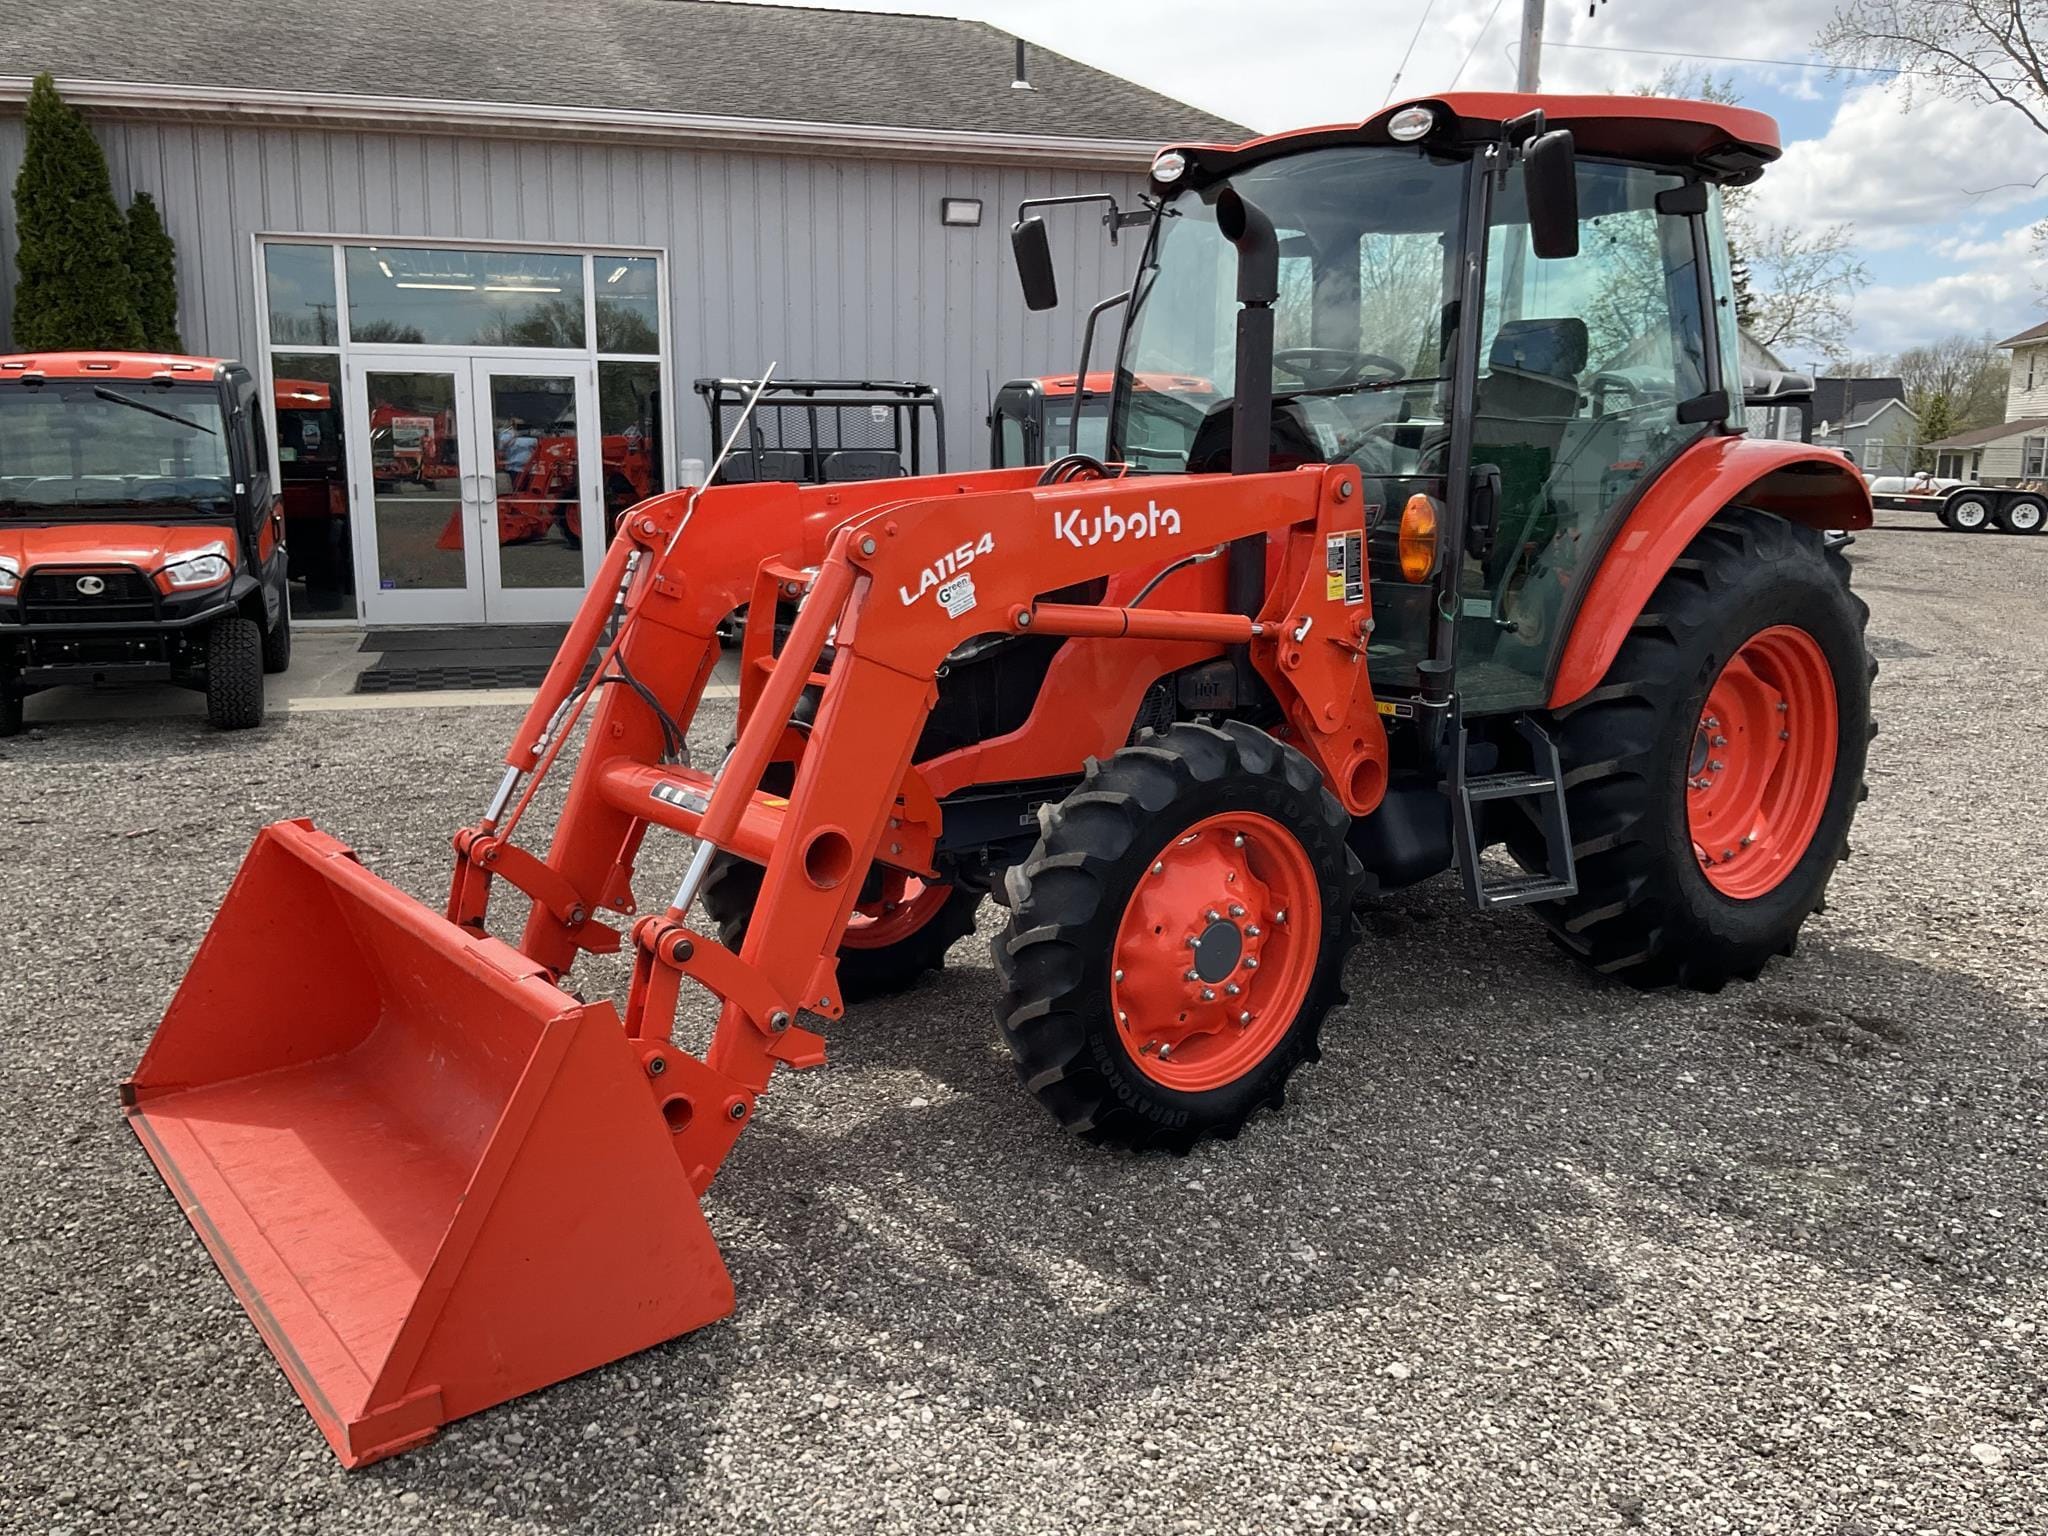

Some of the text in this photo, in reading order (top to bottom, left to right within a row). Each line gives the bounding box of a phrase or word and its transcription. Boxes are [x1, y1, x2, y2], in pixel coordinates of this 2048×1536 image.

[1054, 500, 1181, 547] Kubota
[898, 532, 995, 606] LA1154
[939, 577, 968, 603] Green
[1194, 681, 1220, 697] HOT
